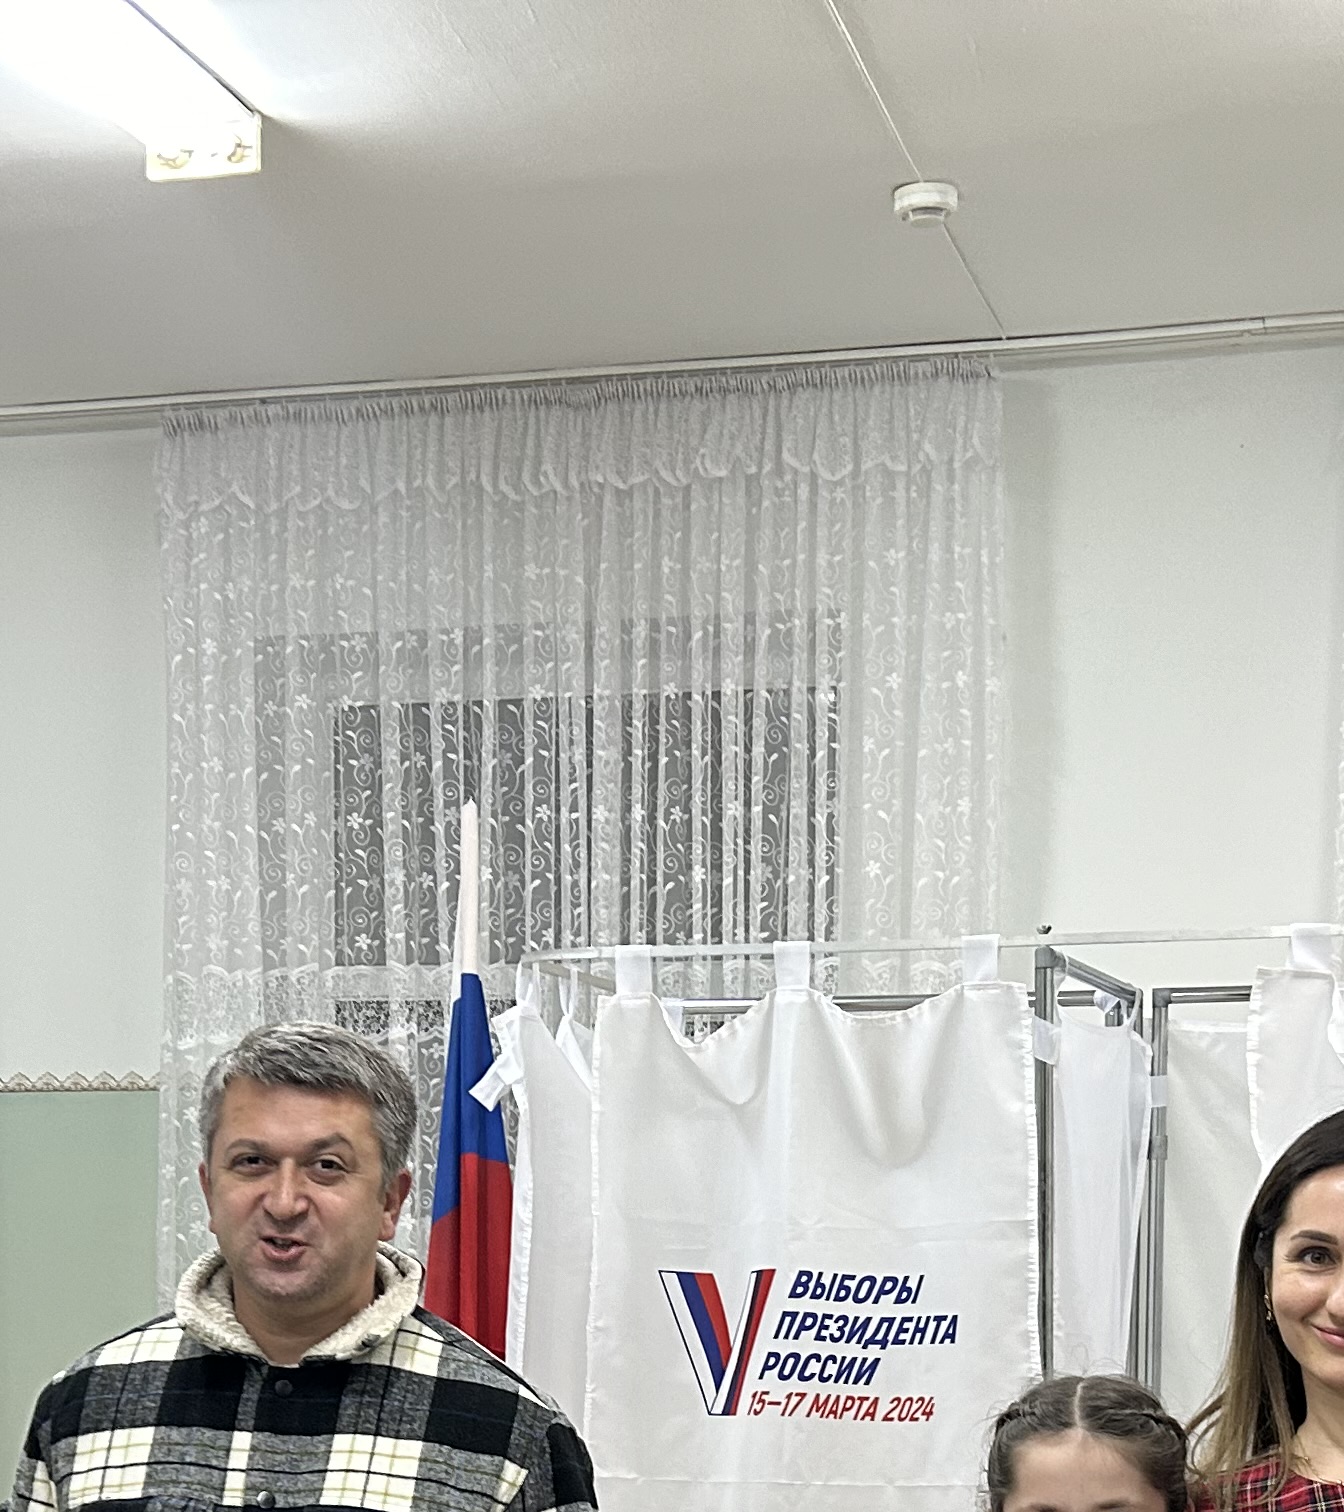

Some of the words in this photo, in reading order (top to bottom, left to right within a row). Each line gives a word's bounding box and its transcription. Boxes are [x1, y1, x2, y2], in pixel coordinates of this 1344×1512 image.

[788, 1270, 925, 1305] ВЫБОРЫ
[772, 1310, 959, 1350] ПРЕЗИДЕНТА
[758, 1351, 881, 1386] РОССИИ
[806, 1393, 877, 1422] МАРТА
[882, 1396, 936, 1422] 2024
